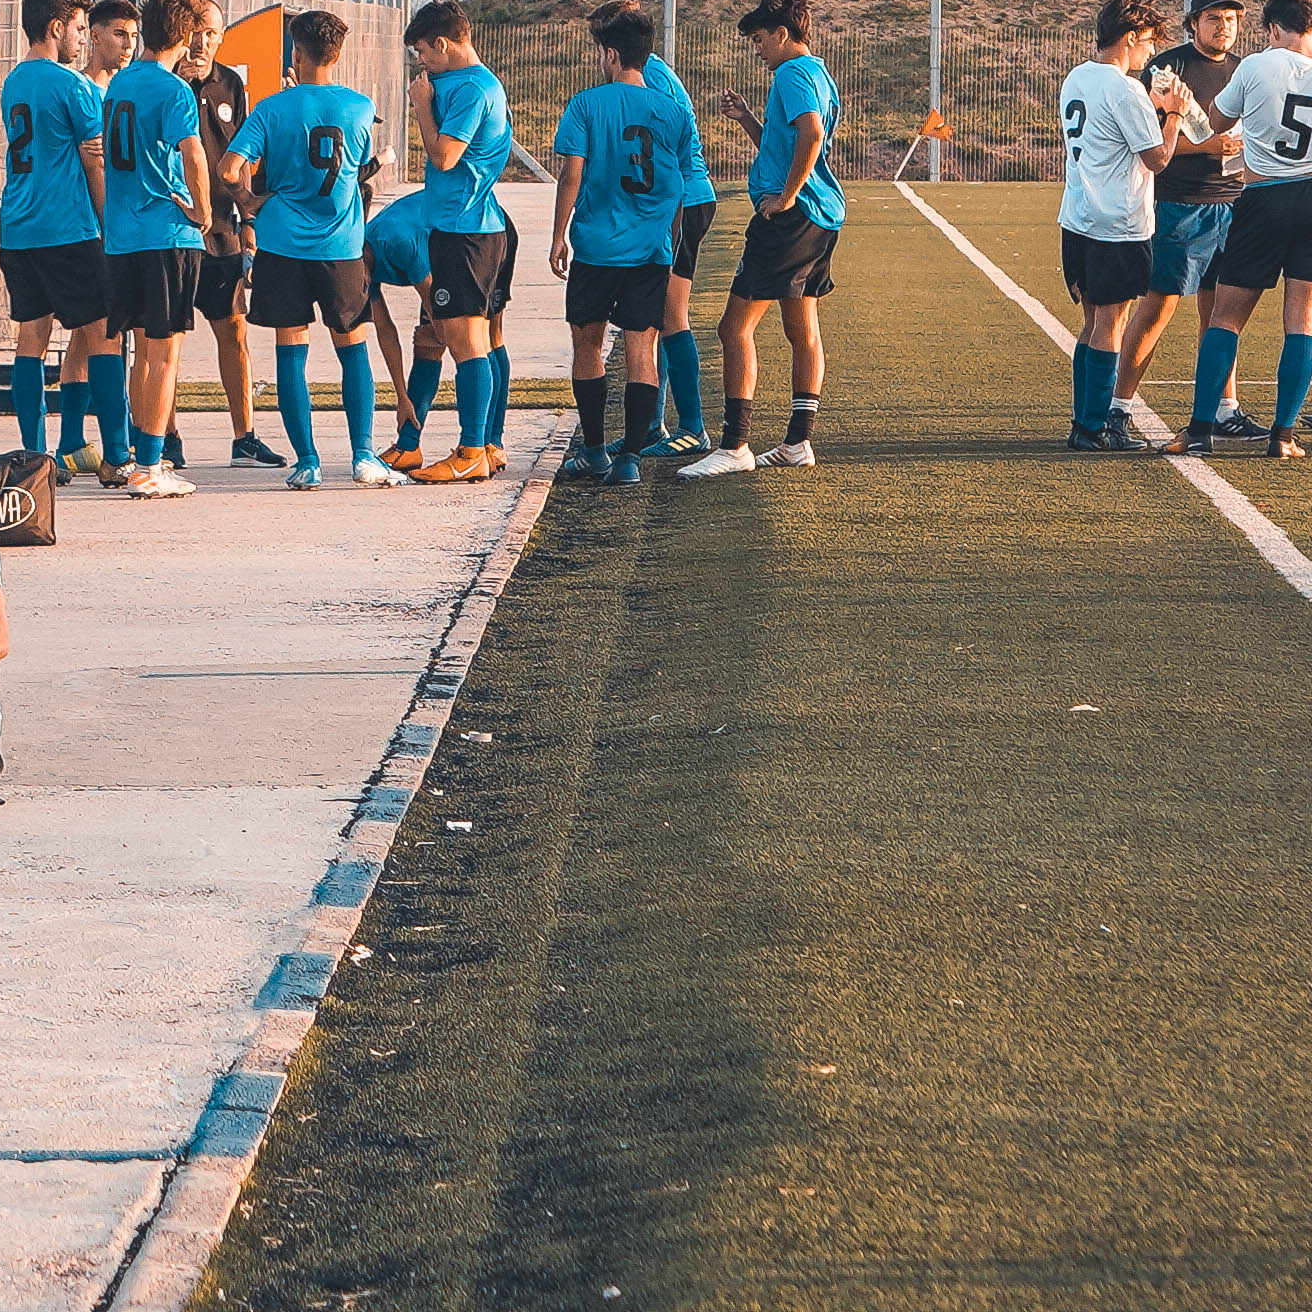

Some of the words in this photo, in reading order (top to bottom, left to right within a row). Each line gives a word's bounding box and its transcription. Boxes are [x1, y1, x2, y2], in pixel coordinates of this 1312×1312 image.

[9, 93, 34, 174] 2
[308, 125, 344, 196] 9
[620, 124, 655, 194] 3
[1065, 99, 1087, 163] 2
